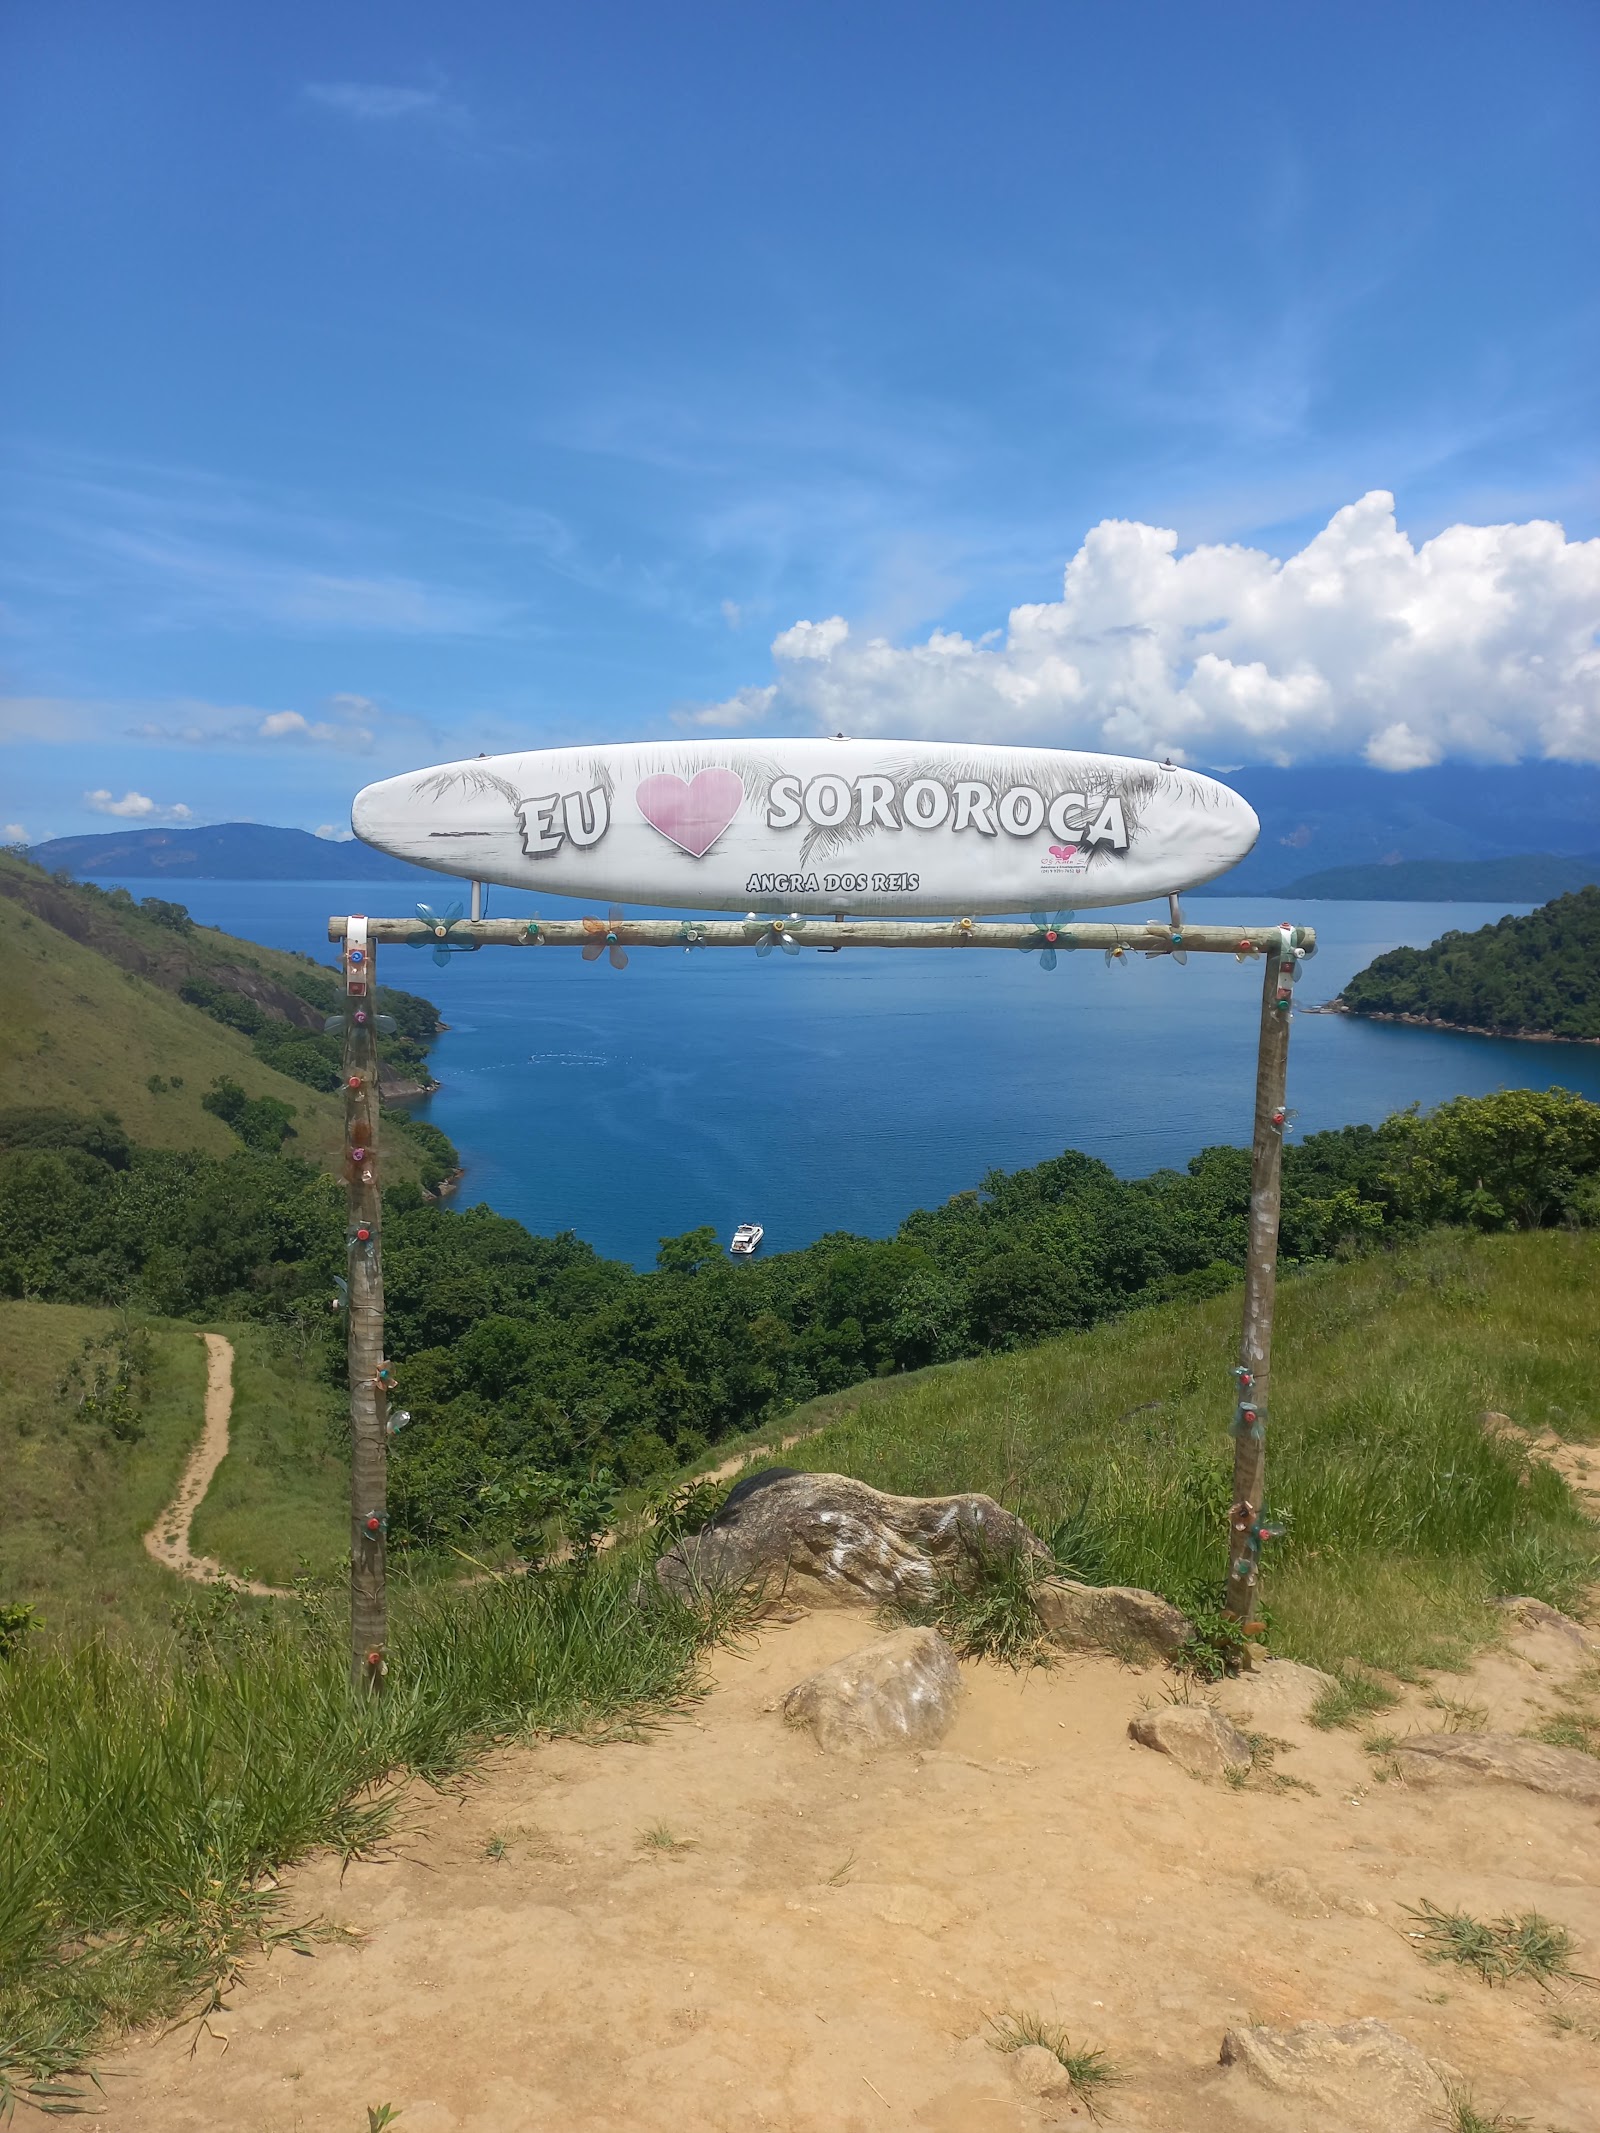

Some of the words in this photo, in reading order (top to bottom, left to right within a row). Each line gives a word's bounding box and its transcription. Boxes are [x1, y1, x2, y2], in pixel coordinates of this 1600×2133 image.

[514, 784, 611, 856] EU
[767, 774, 1130, 851] SOROROCA
[746, 873, 820, 892] ANGRA
[824, 873, 868, 892] DOS
[872, 873, 920, 892] REIS
